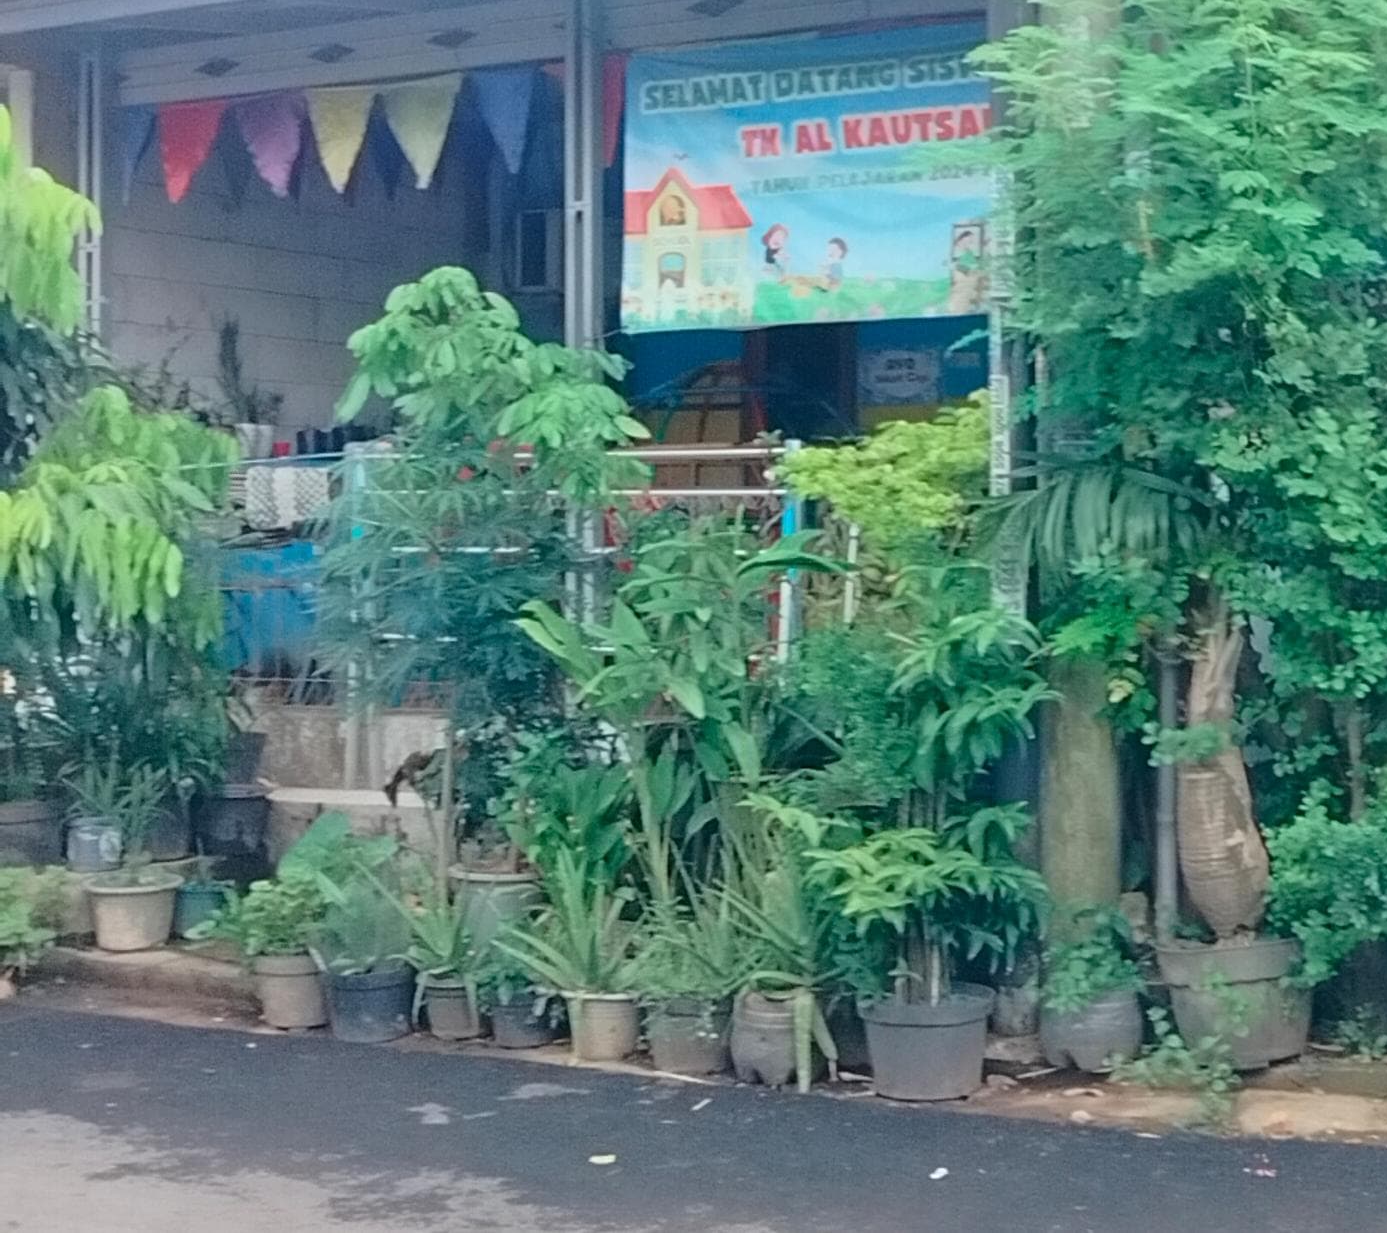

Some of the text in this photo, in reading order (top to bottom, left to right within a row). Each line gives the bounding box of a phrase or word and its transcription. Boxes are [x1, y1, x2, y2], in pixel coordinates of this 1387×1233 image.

[644, 73, 763, 110] SELAMAT
[774, 61, 897, 98] DATANG
[742, 127, 780, 157] TK
[796, 122, 832, 153] AL
